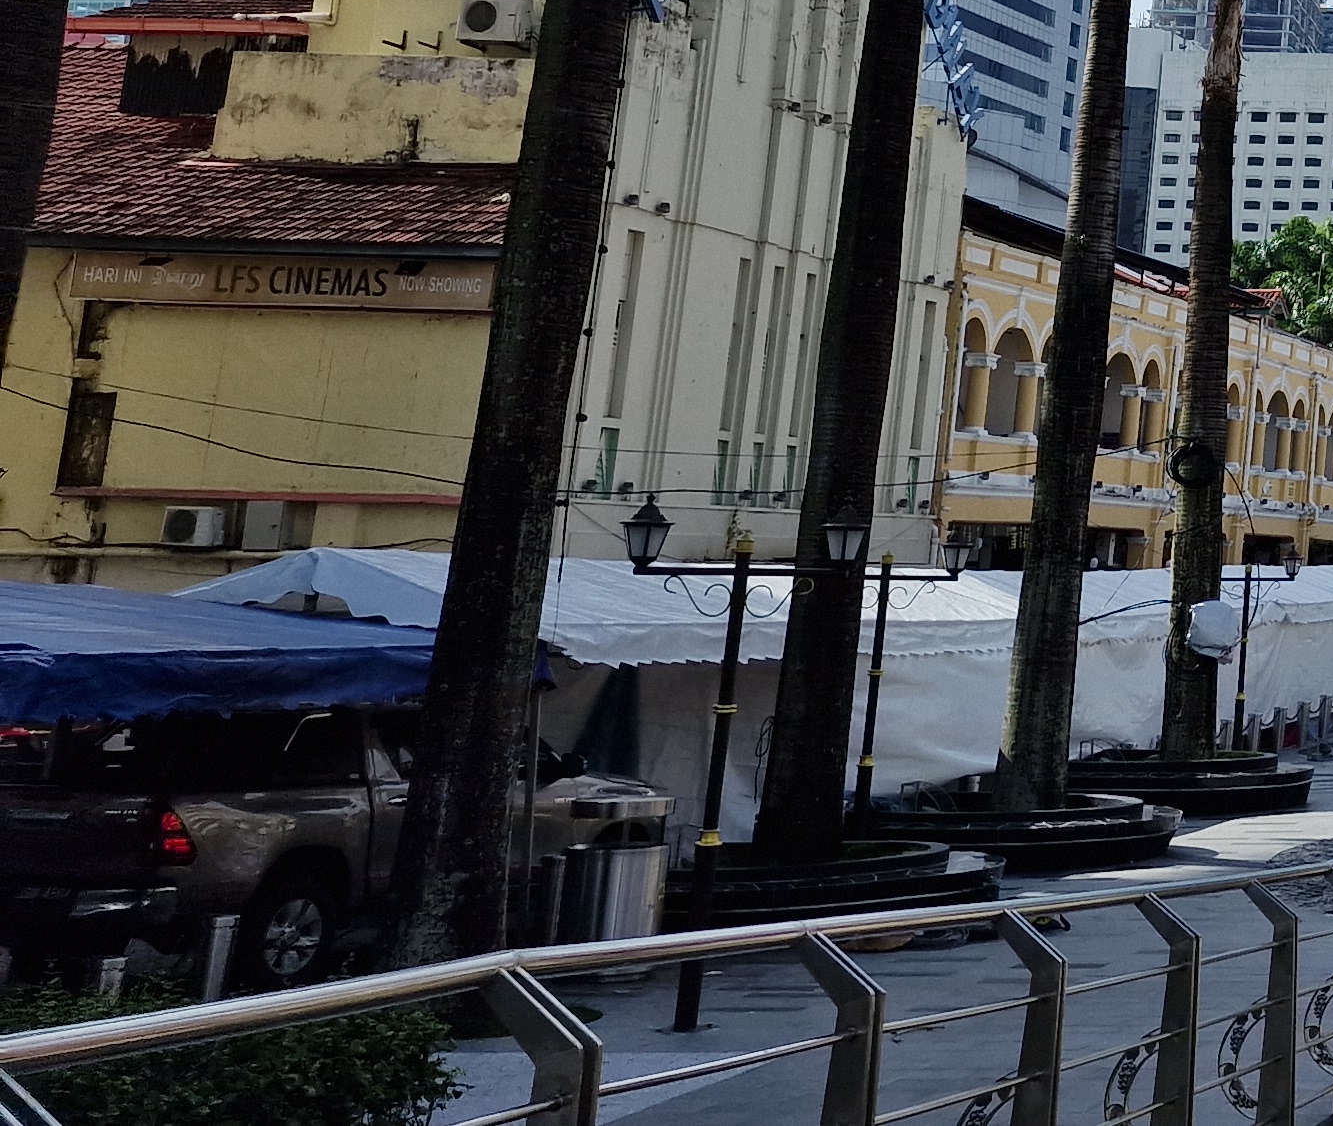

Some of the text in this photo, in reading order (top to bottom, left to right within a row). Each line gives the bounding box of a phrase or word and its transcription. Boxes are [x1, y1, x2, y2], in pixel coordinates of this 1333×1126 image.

[83, 267, 143, 284] HARI INI
[213, 264, 389, 298] LFS CINEMAS
[398, 275, 483, 294] NOW SHOWING
